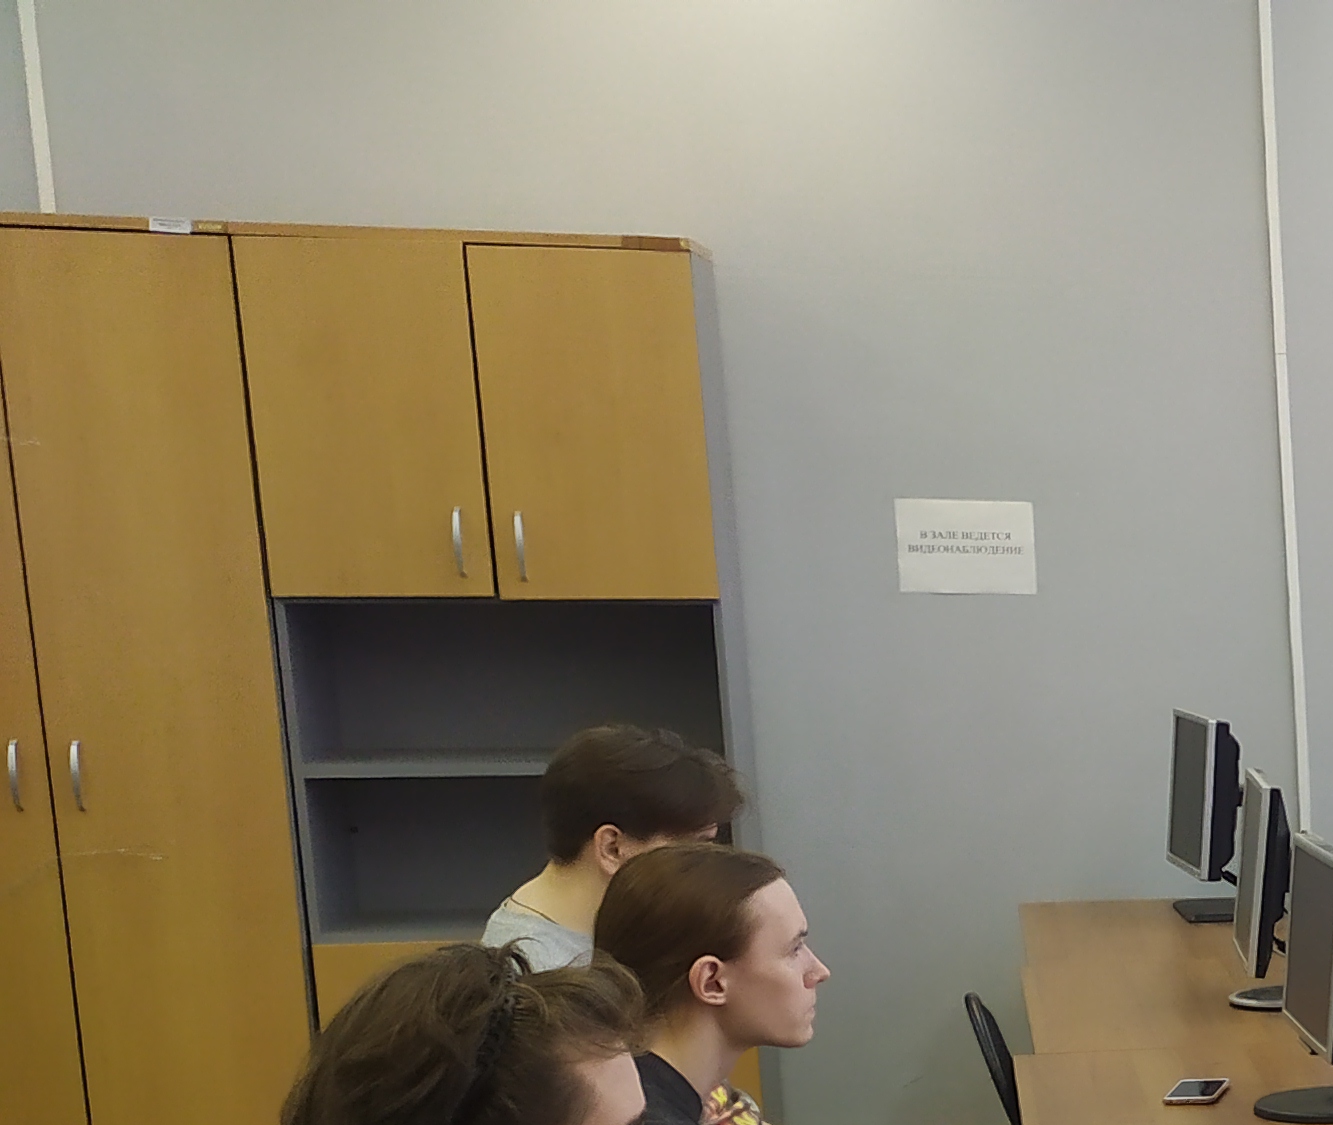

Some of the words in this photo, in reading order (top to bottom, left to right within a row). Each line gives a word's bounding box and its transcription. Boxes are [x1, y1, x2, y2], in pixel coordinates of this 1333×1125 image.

[919, 530, 927, 540] В
[931, 530, 959, 540] ЗАЛЕ
[961, 531, 1011, 542] ВЕДЕТСЯ
[907, 544, 1025, 556] ВИДЕОНАБЛЮДЕНИЕ
